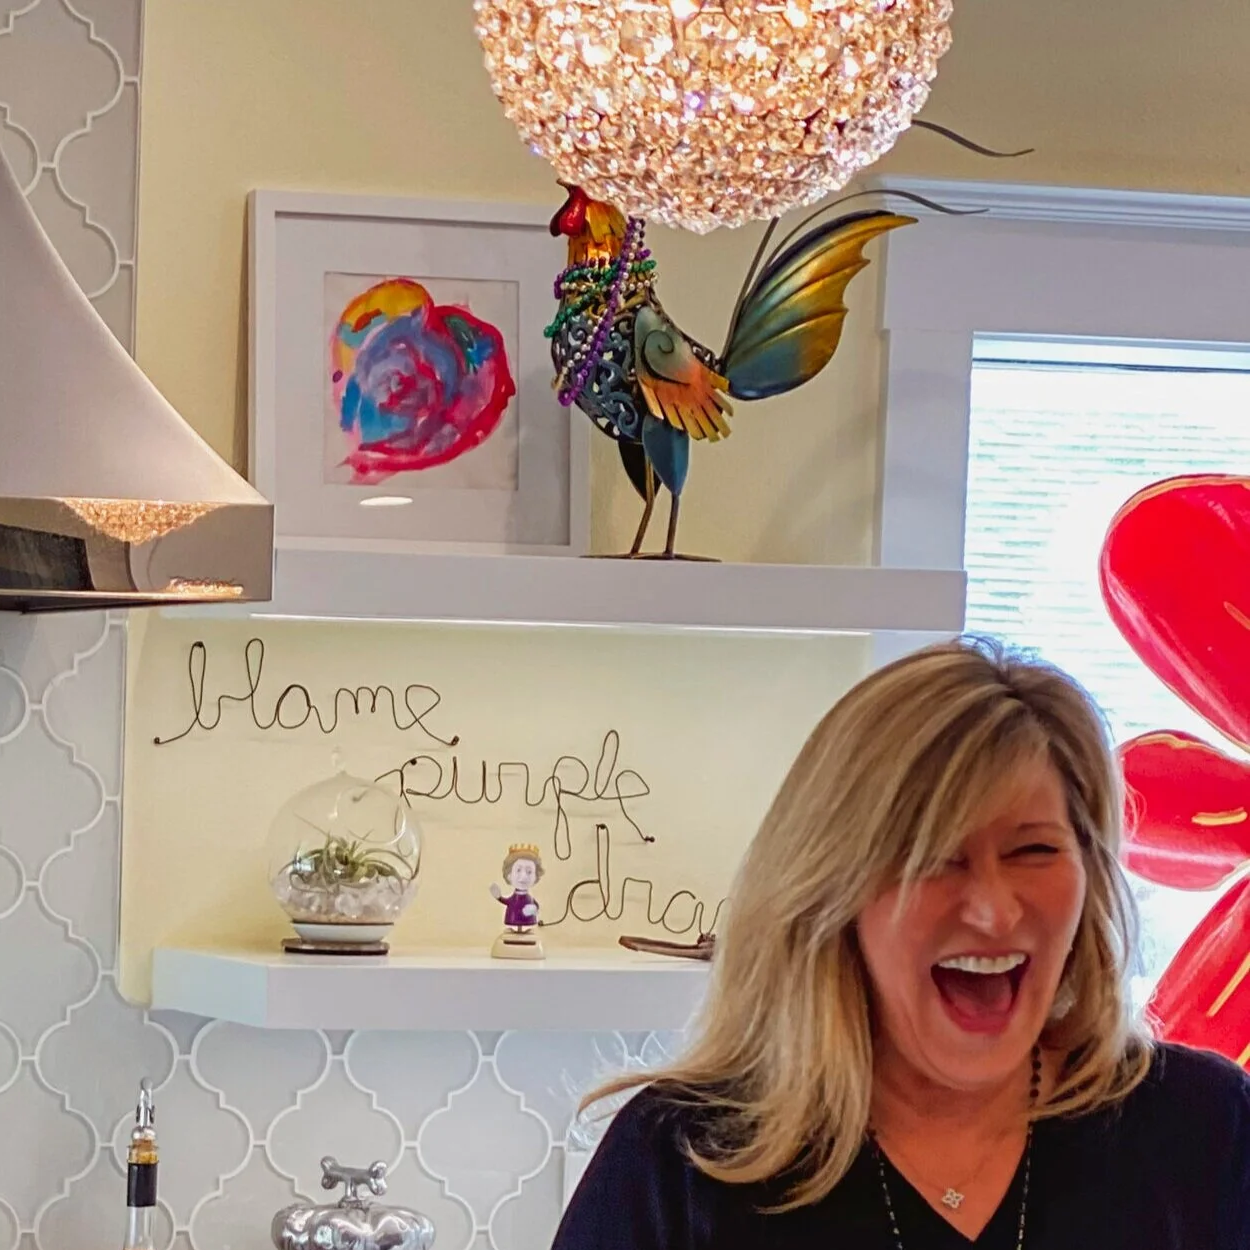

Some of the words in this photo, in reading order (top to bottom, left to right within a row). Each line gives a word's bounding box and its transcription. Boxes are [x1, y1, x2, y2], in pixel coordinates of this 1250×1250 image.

[152, 638, 459, 747] blame
[353, 730, 655, 861] purple
[539, 823, 734, 935] dra
